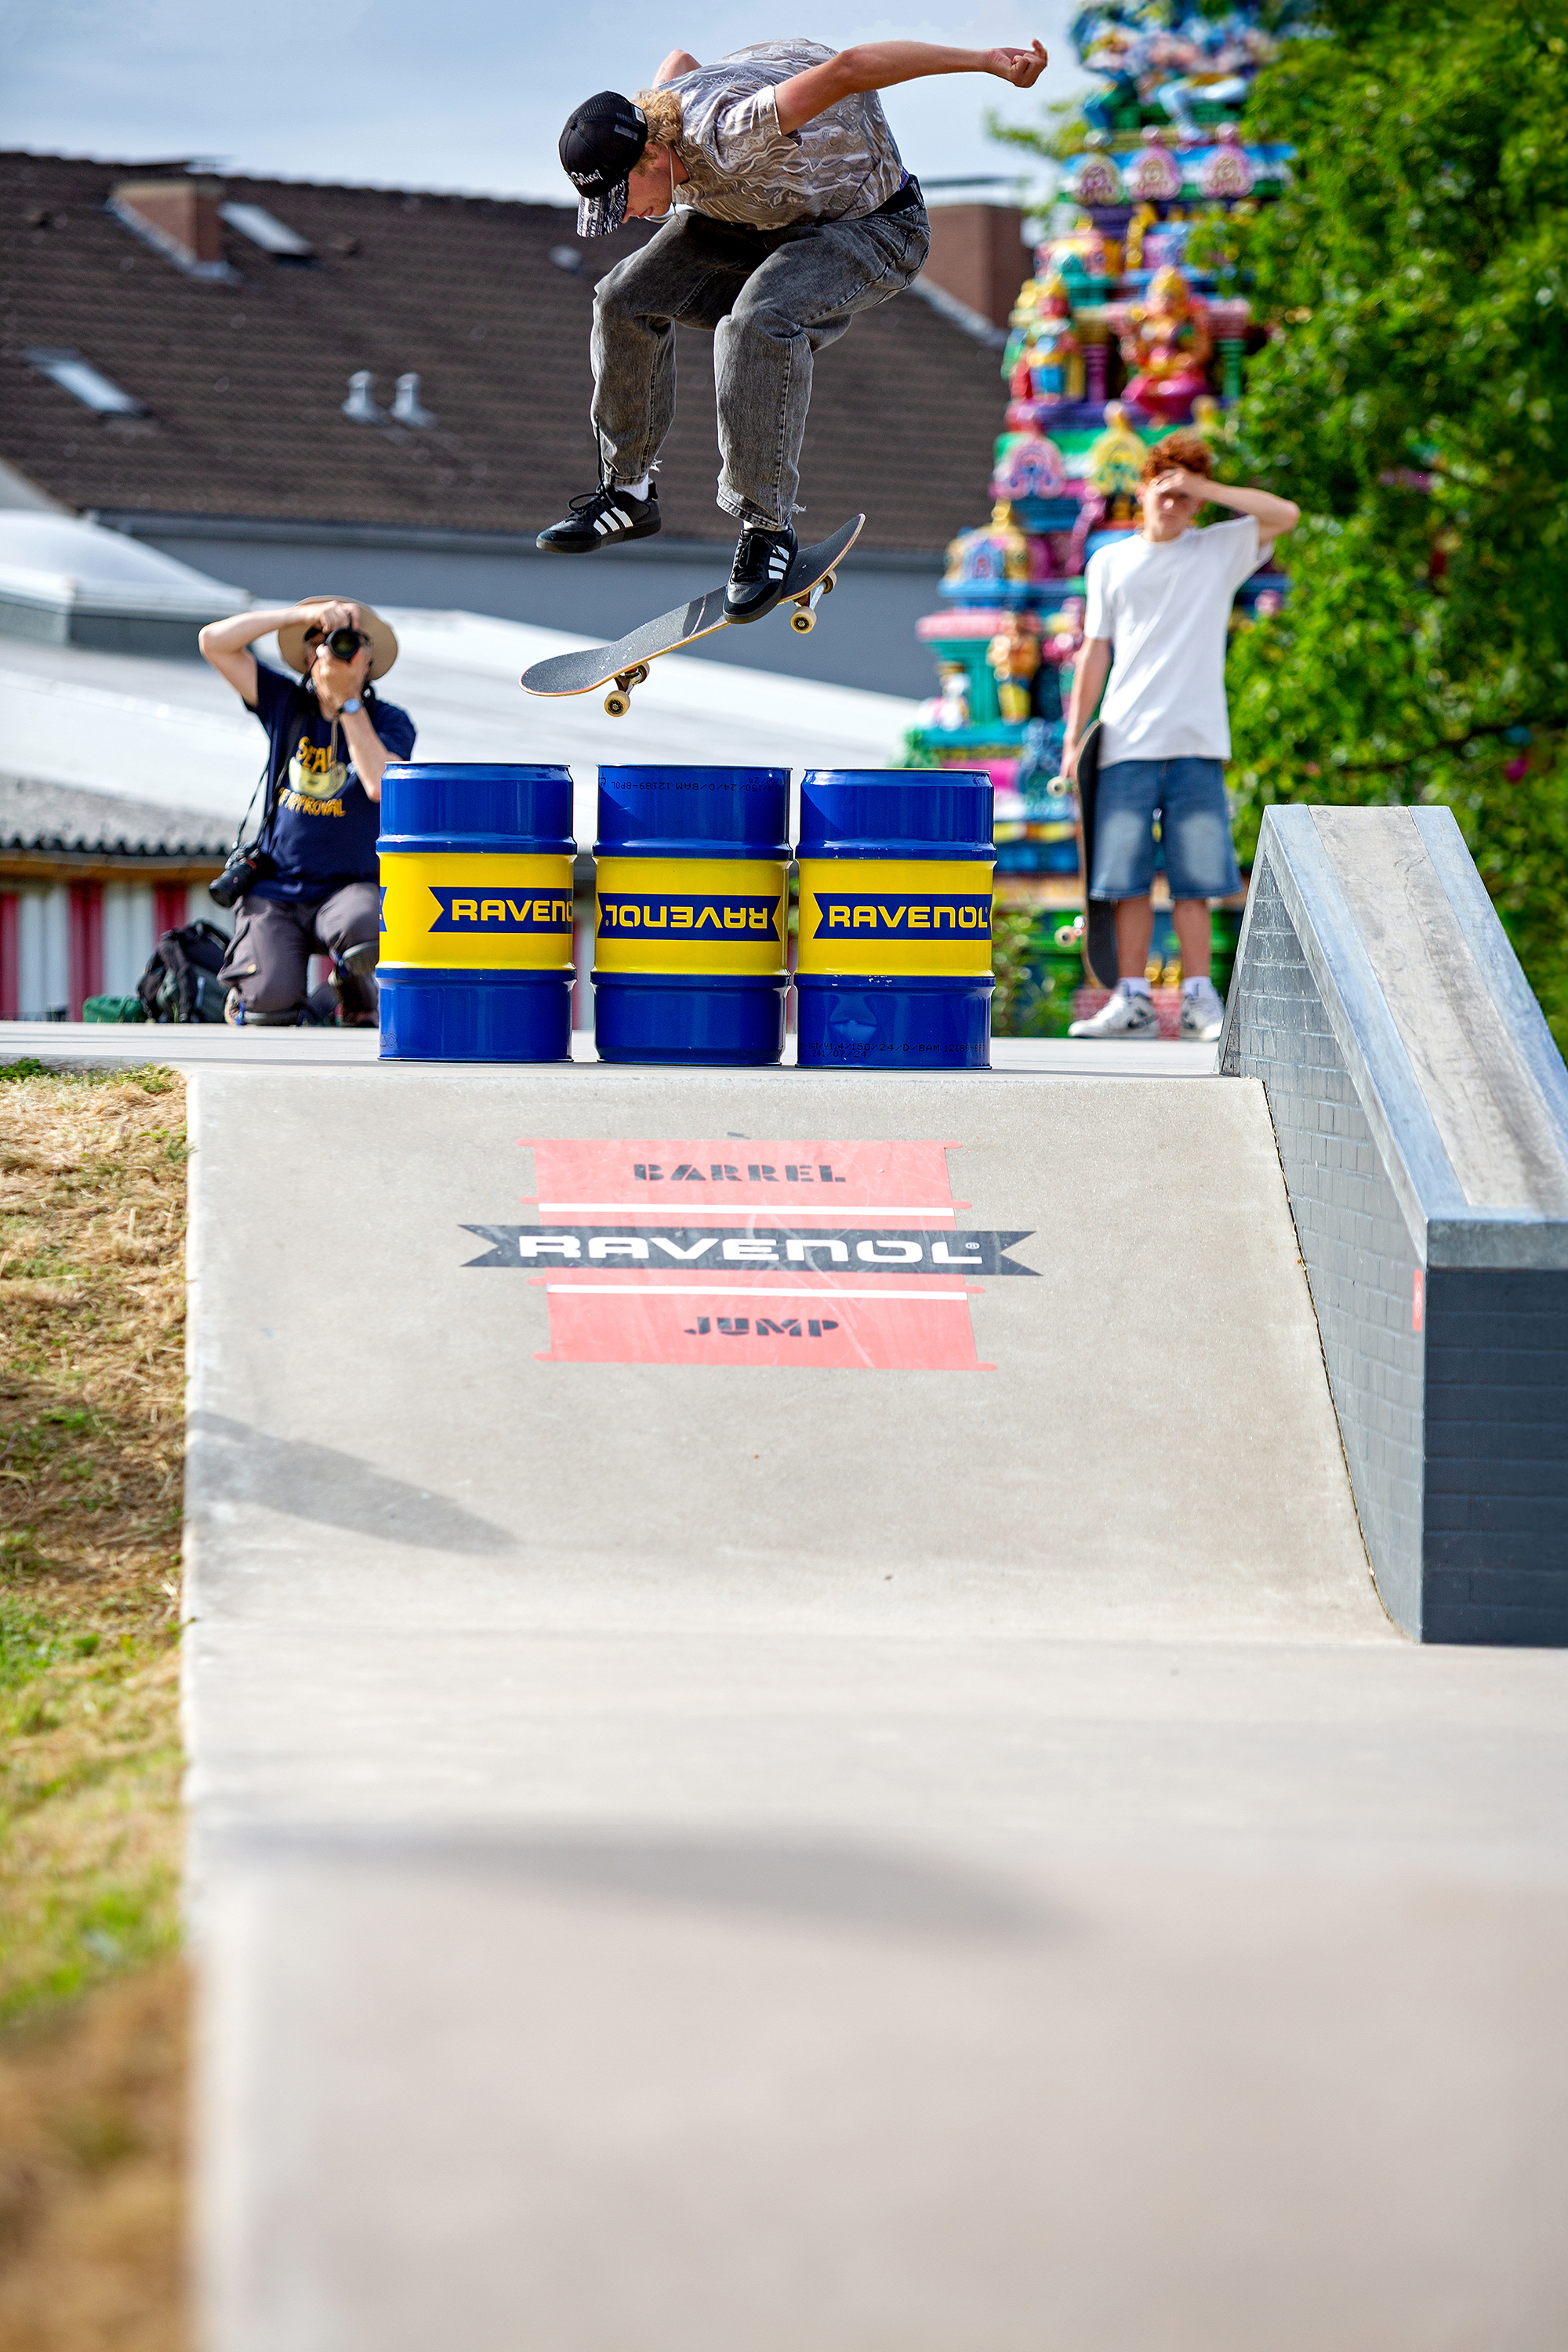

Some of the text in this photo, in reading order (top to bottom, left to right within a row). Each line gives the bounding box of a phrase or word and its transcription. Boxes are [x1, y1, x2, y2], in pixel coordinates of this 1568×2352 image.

[296, 736, 337, 773] SEAL
[285, 791, 347, 818] APPROVAL
[606, 905, 768, 928] RAVENOL
[829, 906, 988, 928] RAVENOL
[633, 1163, 846, 1182] BARREL
[518, 1235, 983, 1265] RAVENOL
[684, 1316, 840, 1338] JUMP
